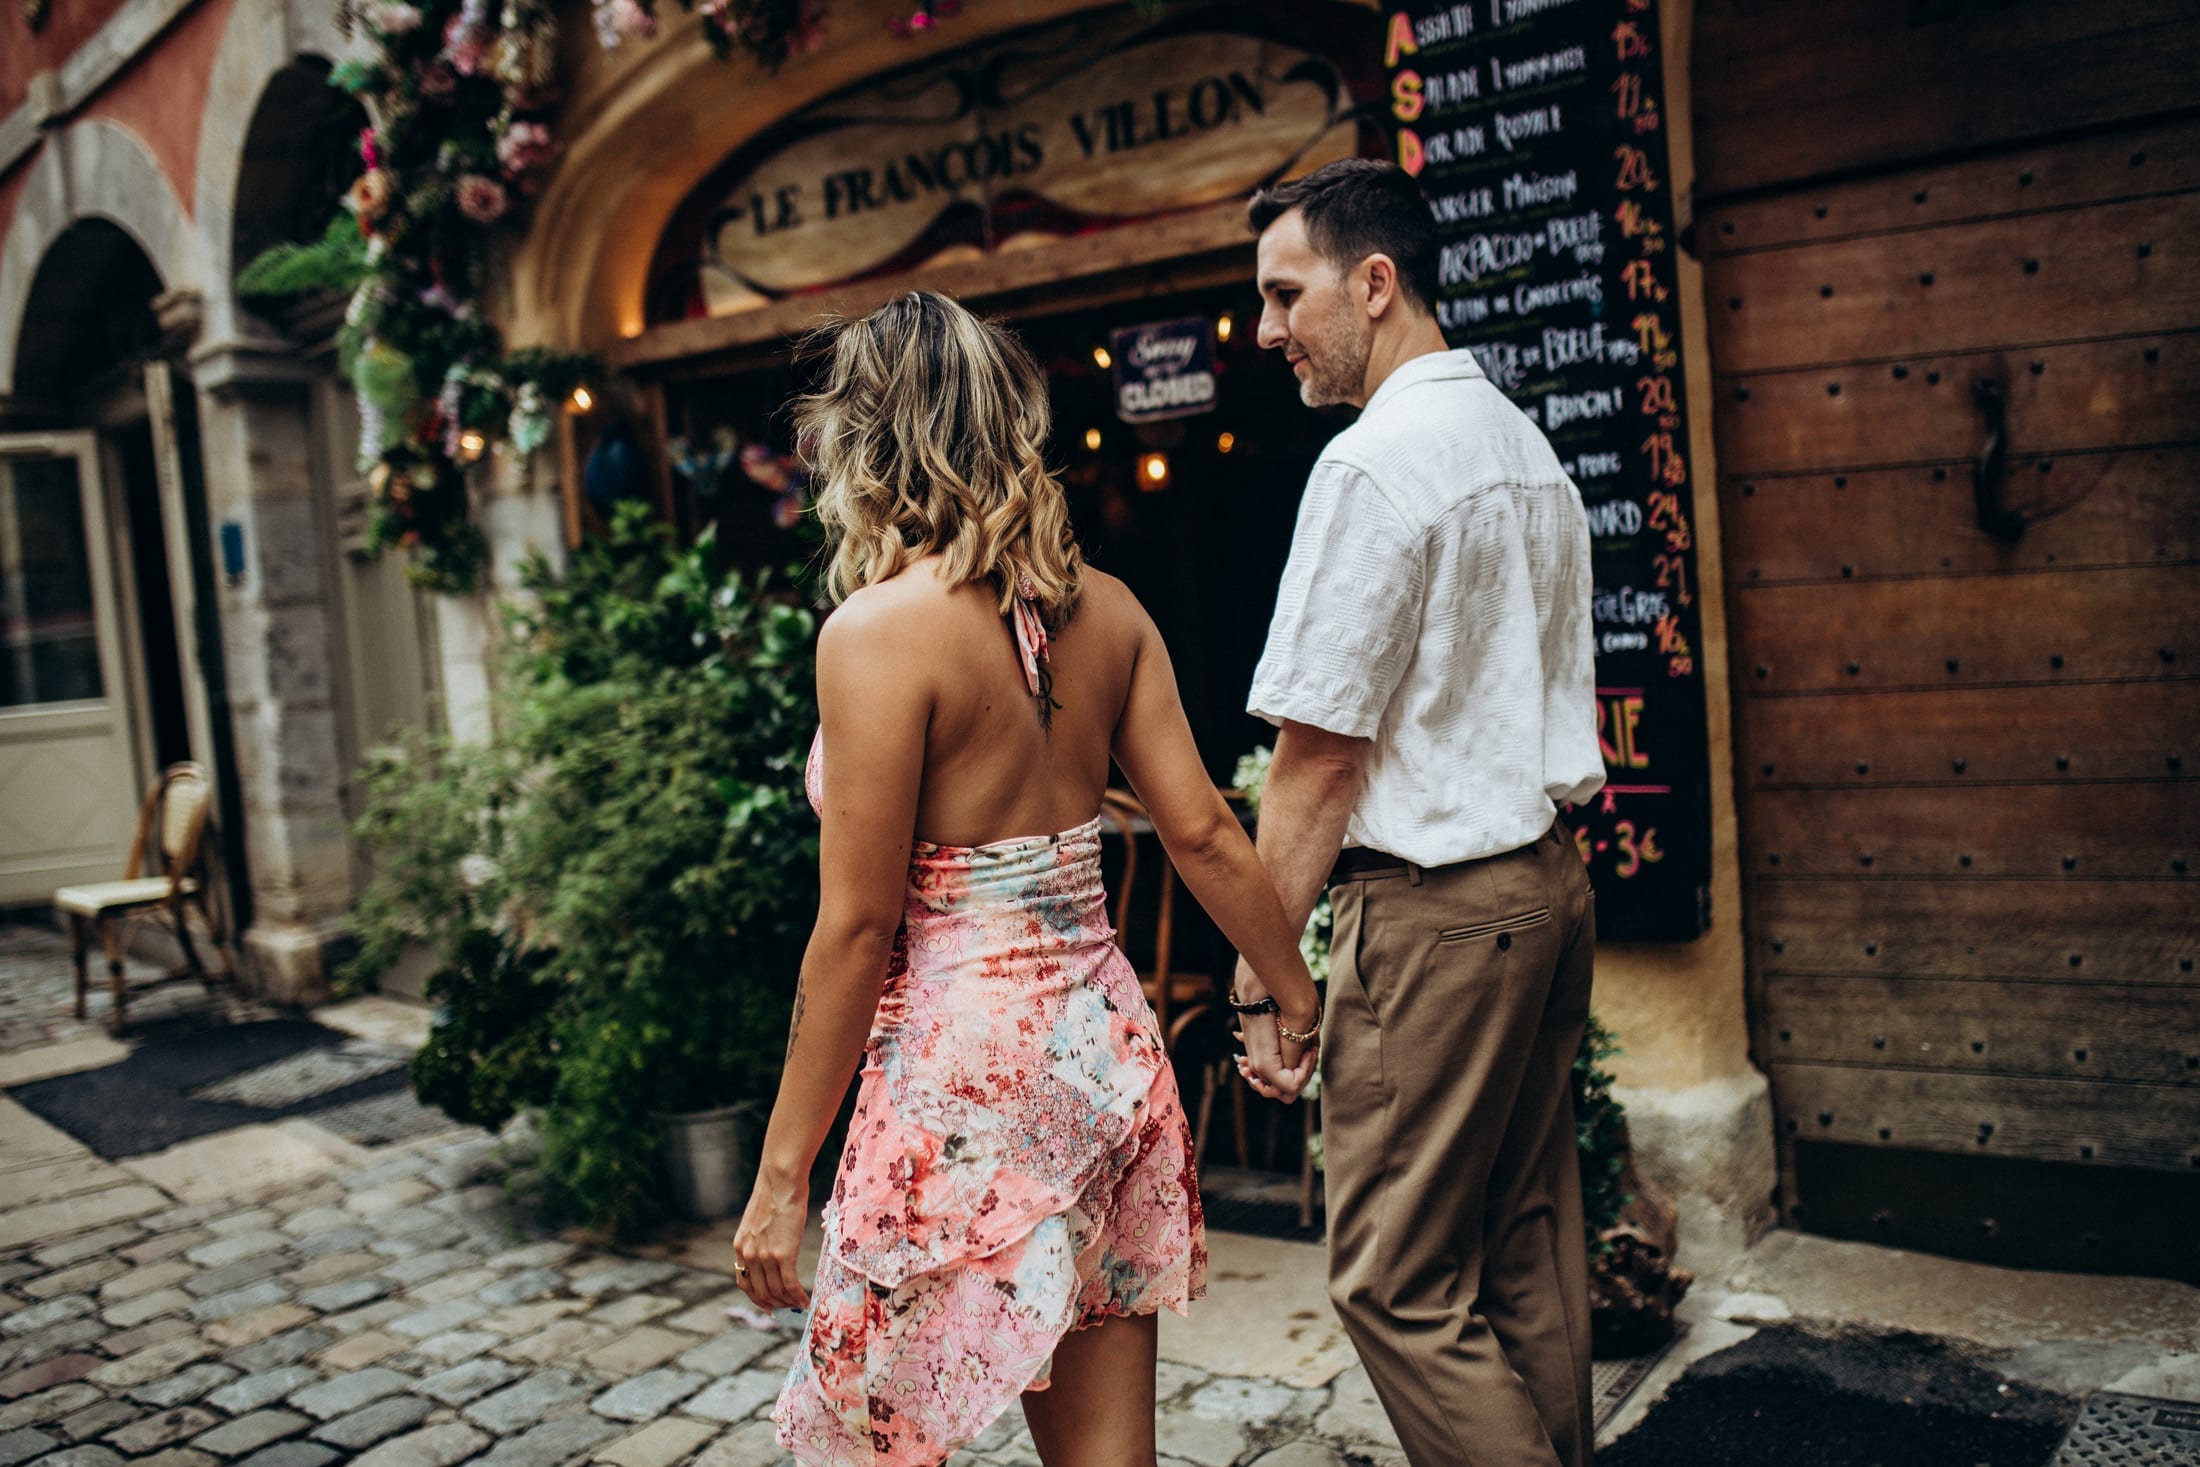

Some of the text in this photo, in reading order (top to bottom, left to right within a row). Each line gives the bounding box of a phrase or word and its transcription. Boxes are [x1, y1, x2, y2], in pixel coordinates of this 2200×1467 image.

[751, 183, 804, 237] LE
[1069, 70, 1265, 158] VILLON
[1429, 186, 1495, 224] URGER
[1127, 332, 1198, 368] Sorry
[1119, 371, 1215, 411] CLOSED
